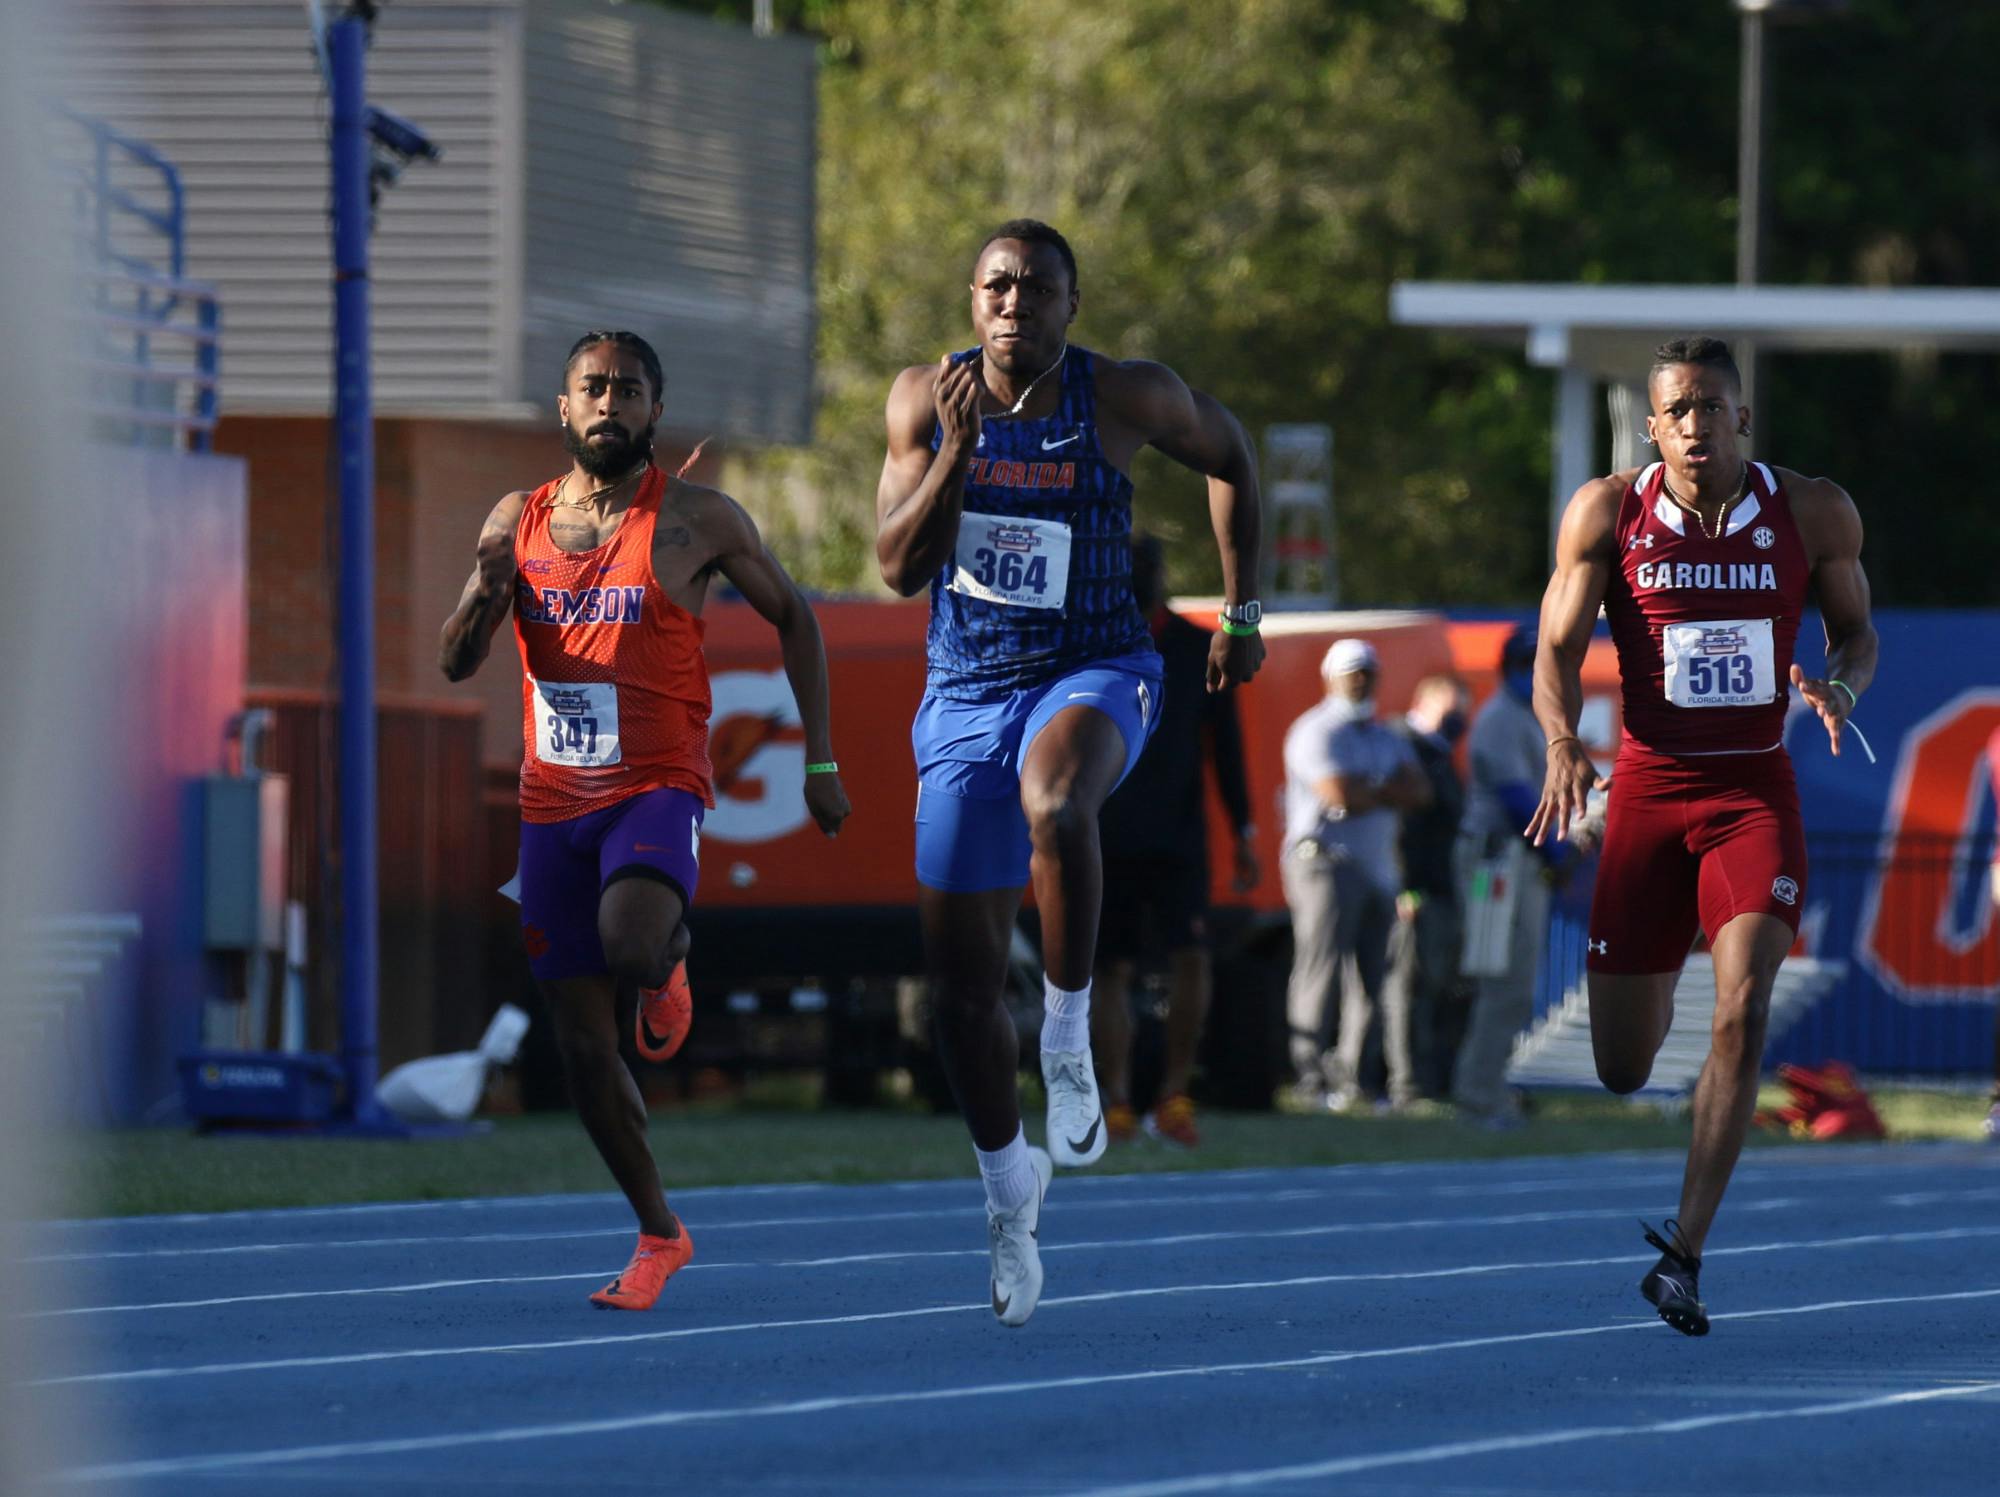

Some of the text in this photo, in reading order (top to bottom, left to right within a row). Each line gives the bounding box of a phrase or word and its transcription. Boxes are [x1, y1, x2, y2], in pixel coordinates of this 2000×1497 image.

[1754, 528, 1774, 548] SEC
[523, 559, 553, 573] ACC
[973, 547, 1048, 594] 364
[1637, 562, 1777, 590] CAROLINA
[1010, 593, 1043, 604] RELAYS
[1689, 654, 1754, 695] 513
[547, 715, 598, 754] 347
